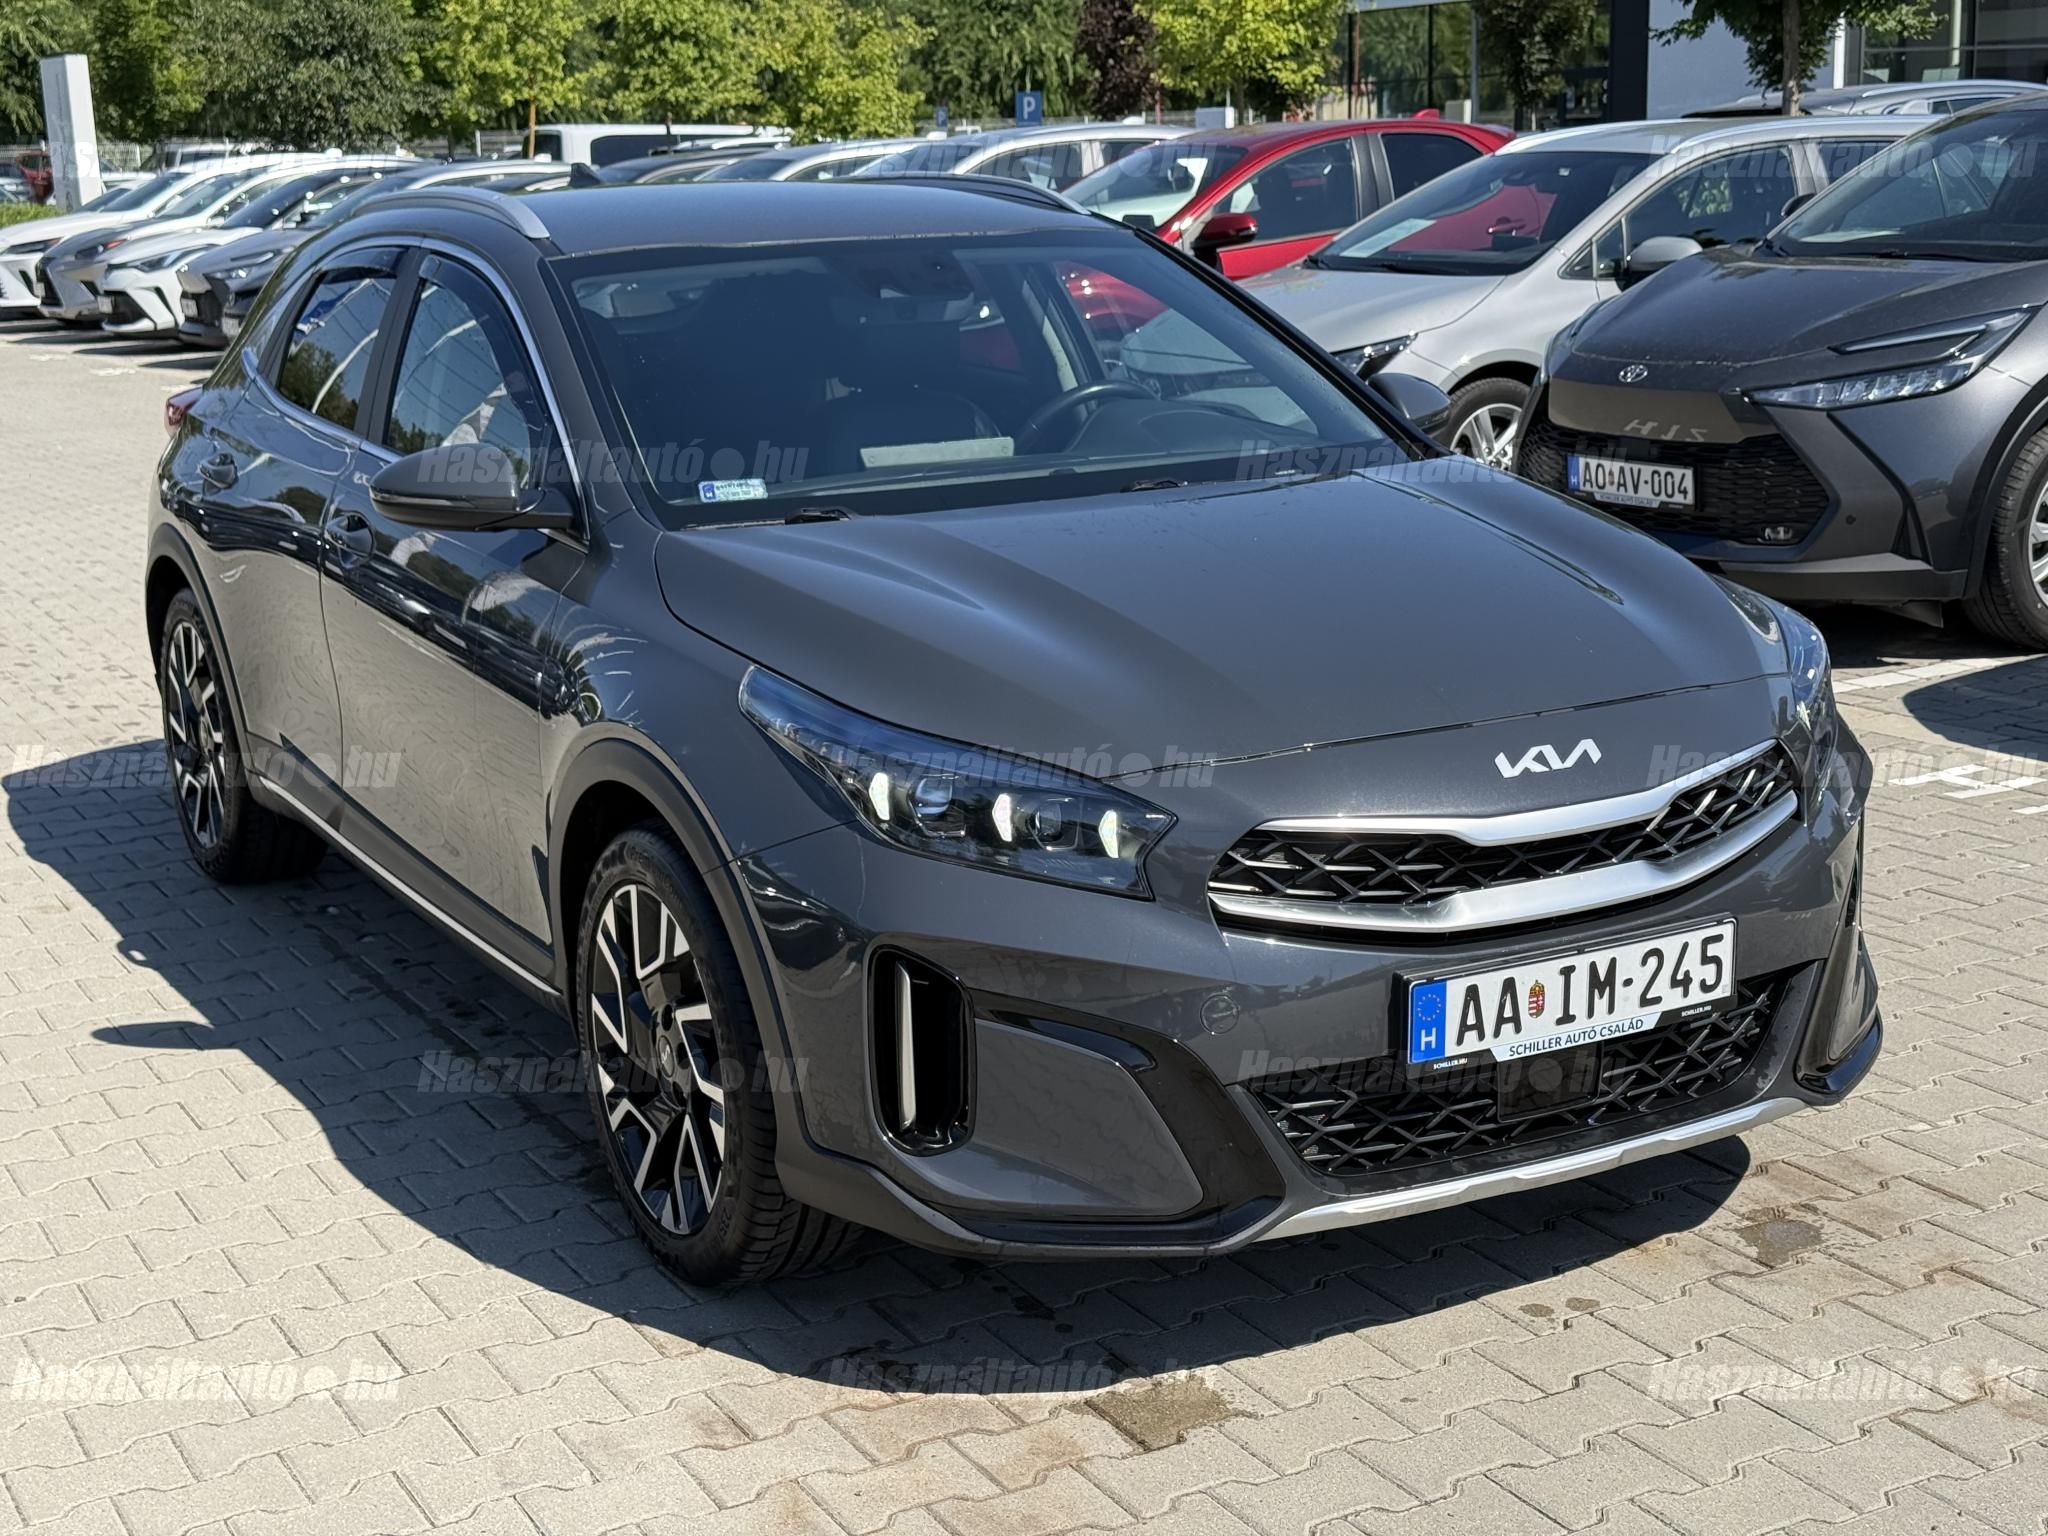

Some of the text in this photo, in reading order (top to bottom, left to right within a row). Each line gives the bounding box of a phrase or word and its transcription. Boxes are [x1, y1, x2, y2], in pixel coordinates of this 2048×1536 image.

[1023, 96, 1035, 120] P
[1582, 461, 1606, 490] AO
[1616, 466, 1688, 500] AV-004
[1494, 738, 1602, 779] KIA
[1456, 934, 1724, 1047] AA IM-245
[1509, 1018, 1643, 1057] SCHILLER AUTÓ CSALÁD
